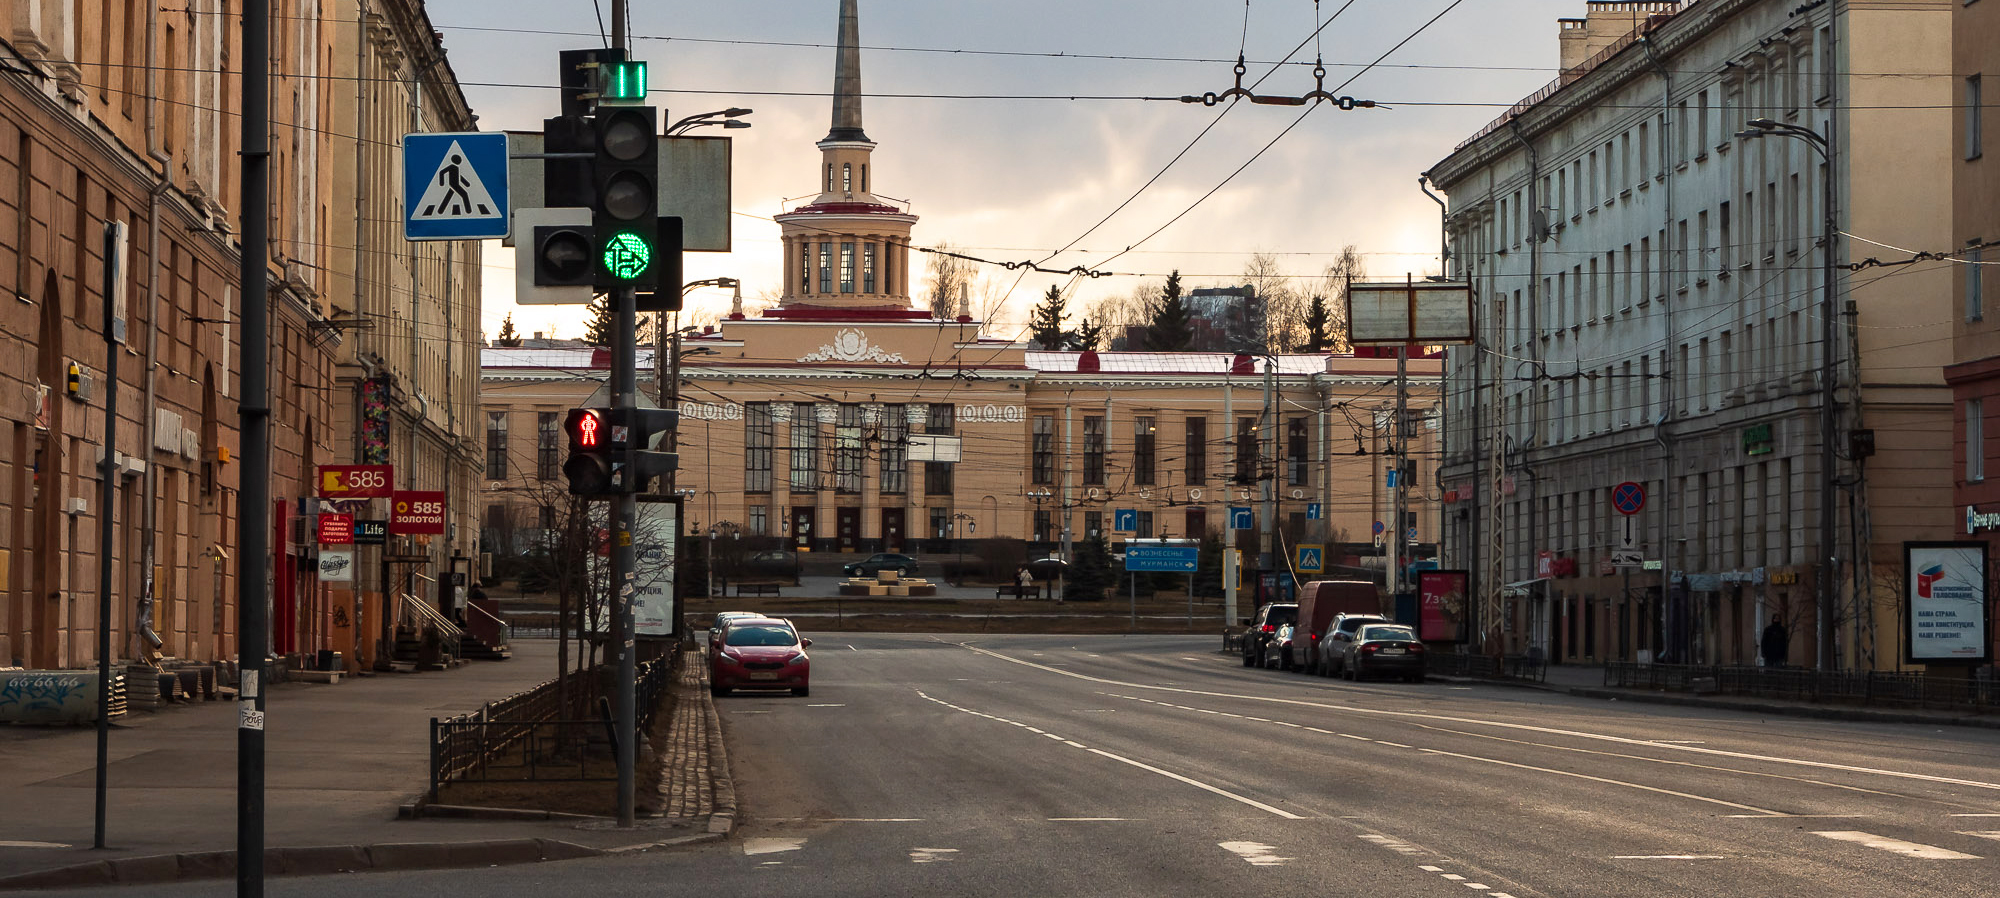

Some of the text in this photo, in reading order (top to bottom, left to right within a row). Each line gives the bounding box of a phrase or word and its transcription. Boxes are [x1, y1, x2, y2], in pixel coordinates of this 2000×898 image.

[349, 470, 385, 488] 585
[412, 501, 442, 514] 585
[396, 515, 442, 524] ЗОЛОТОЙ
[1935, 621, 1975, 629] КОНСТИТУЦИЯ,
